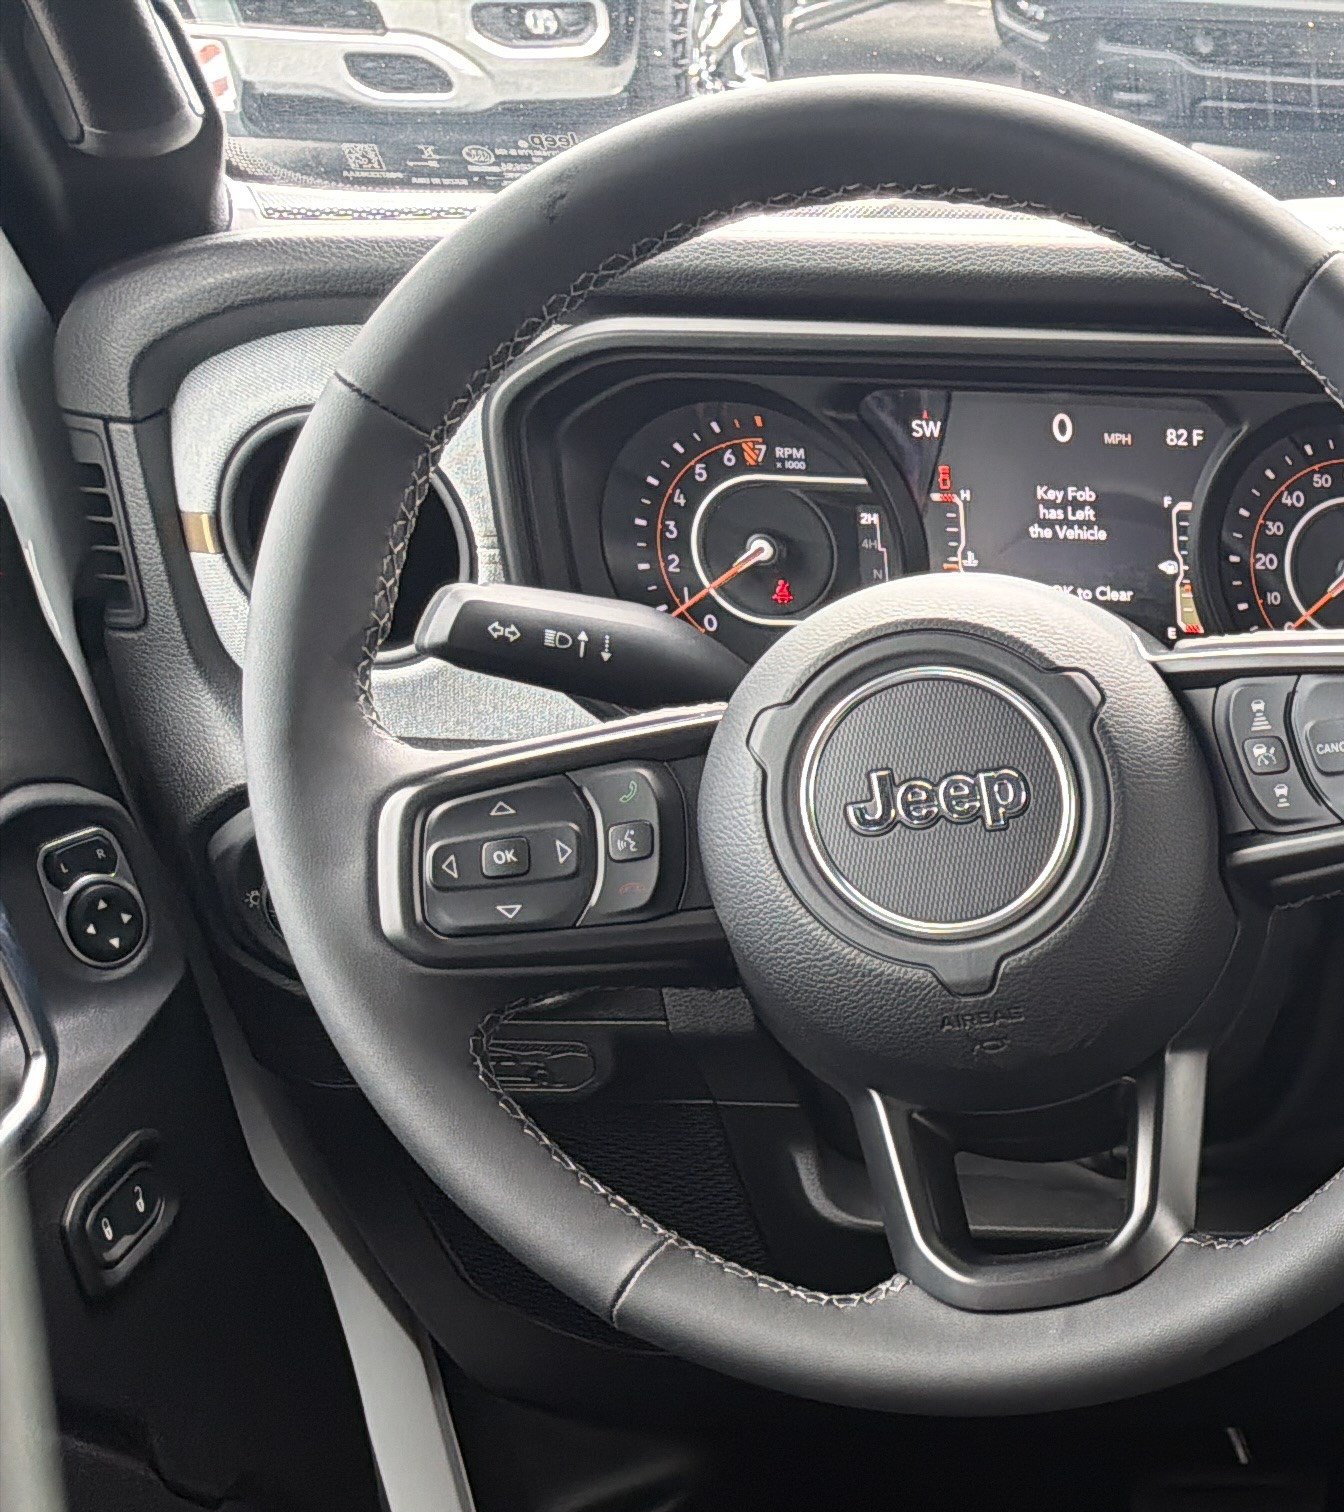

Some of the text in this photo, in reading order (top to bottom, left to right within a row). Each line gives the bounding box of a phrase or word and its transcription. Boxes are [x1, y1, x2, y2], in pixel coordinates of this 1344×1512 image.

[911, 419, 941, 438] SW
[1052, 413, 1073, 443] 0
[1104, 433, 1132, 446] MPH
[1165, 428, 1204, 447] 82 F
[723, 449, 736, 466] 6
[775, 447, 805, 460] RPM
[694, 463, 707, 482] 5
[785, 460, 806, 471] 1000
[1312, 473, 1332, 488] 50
[674, 488, 687, 506] 4
[959, 489, 971, 501] H
[1036, 485, 1097, 502] Key Fob
[1281, 491, 1304, 508] 40
[1163, 496, 1172, 508] F
[860, 513, 877, 524] 2H
[1039, 506, 1096, 522] has Left
[664, 521, 678, 539] 3
[1029, 525, 1108, 541] the Vehicle
[1265, 521, 1284, 536] 30
[667, 554, 681, 573] 2
[1255, 553, 1278, 570] 20
[873, 568, 884, 580] N
[1077, 586, 1134, 602] to Clear
[1266, 591, 1281, 605] 10
[703, 614, 718, 632] 0
[1166, 628, 1177, 640] E
[847, 766, 1030, 837] Jeep
[95, 848, 107, 860] R
[492, 849, 519, 866] OK
[60, 862, 69, 874] L
